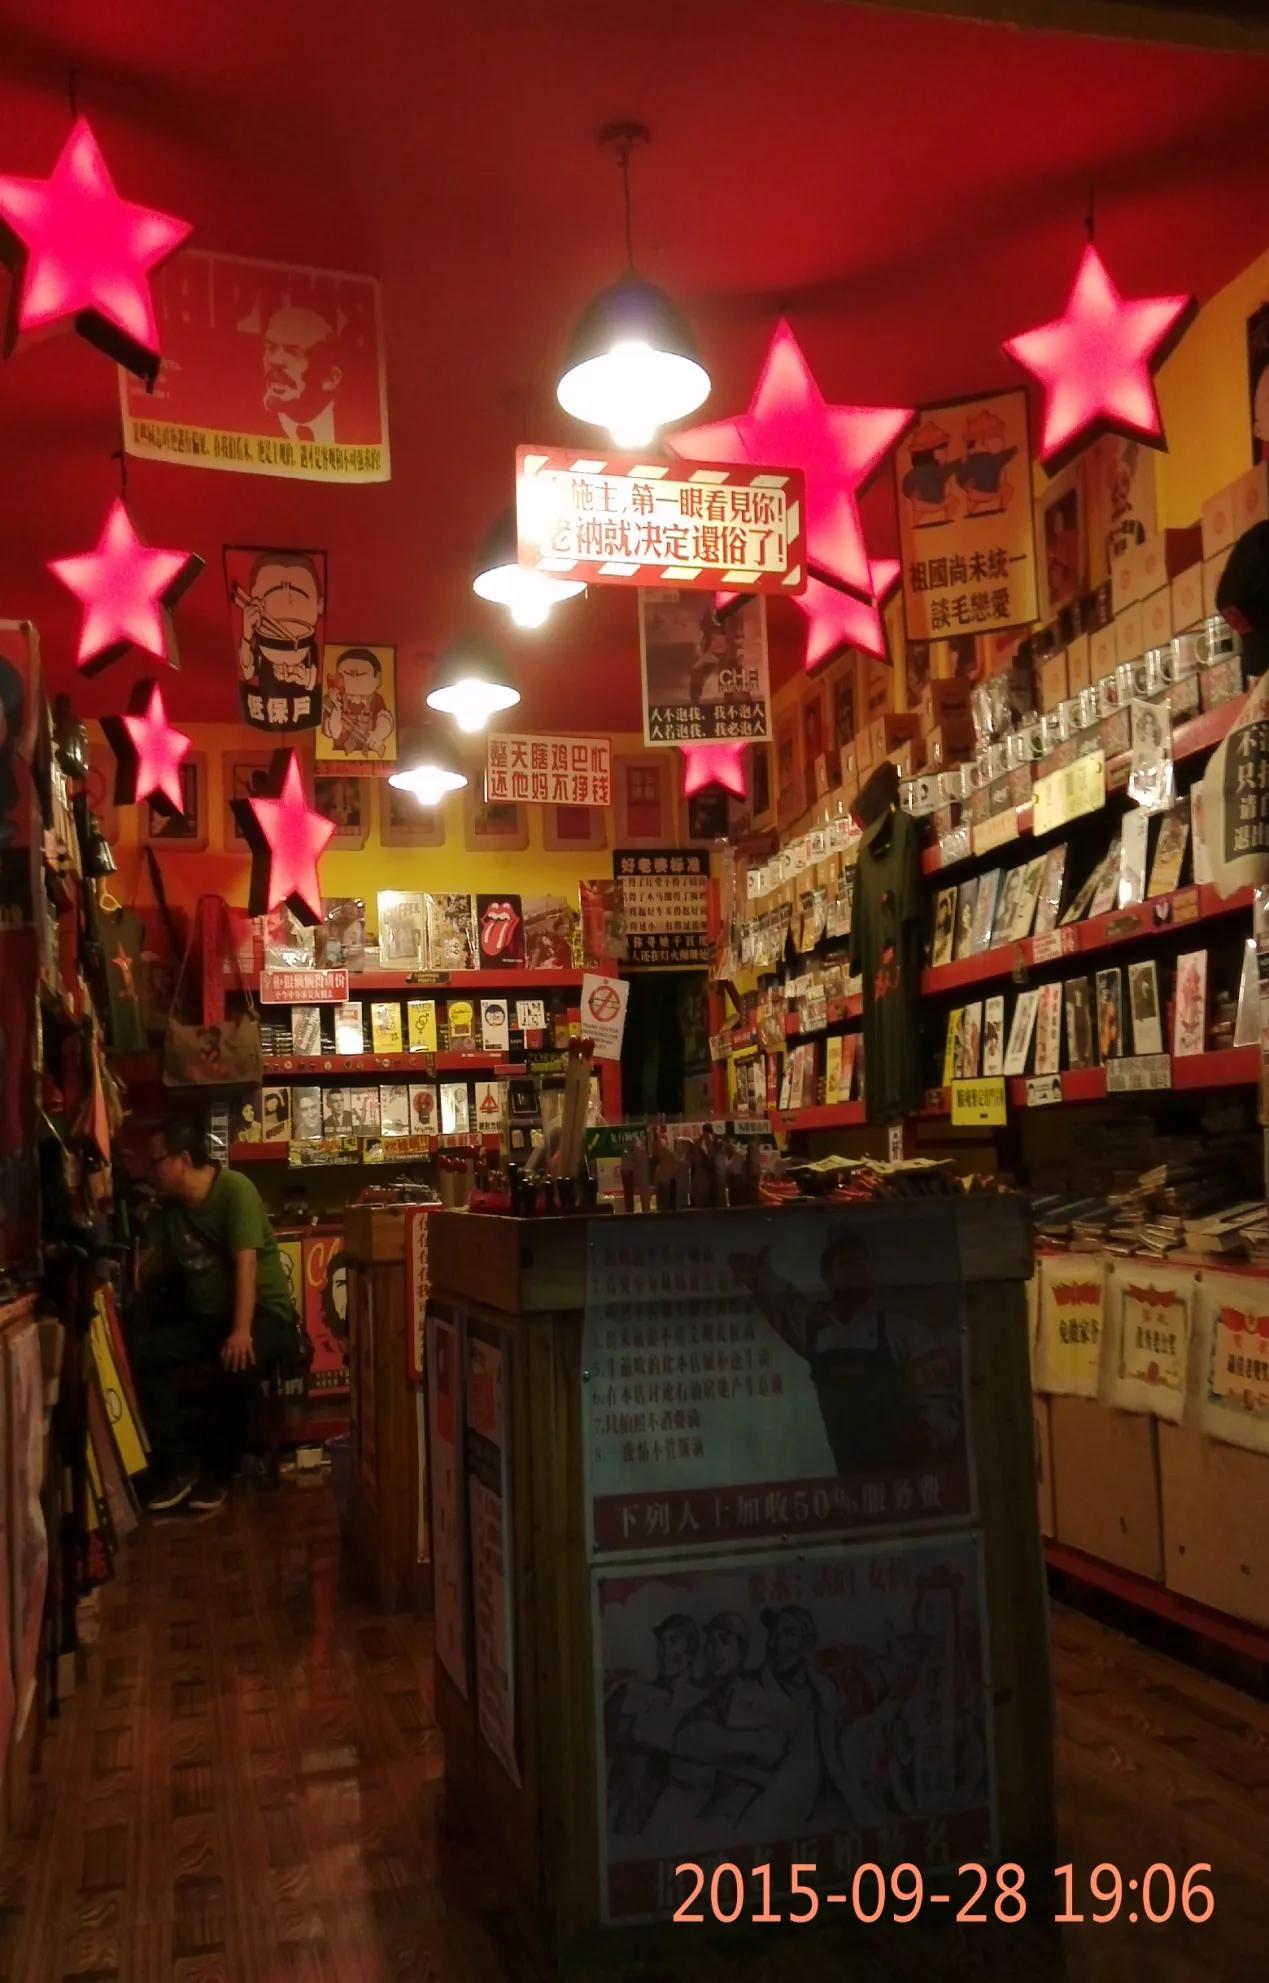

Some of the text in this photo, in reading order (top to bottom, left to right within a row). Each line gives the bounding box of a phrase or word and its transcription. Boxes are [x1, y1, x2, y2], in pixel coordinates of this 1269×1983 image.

[909, 548, 1027, 592] 祖國尚未統一
[931, 588, 1010, 630] 談毛戀愛
[490, 740, 608, 774] 整天瞎鸡巴忙
[490, 769, 609, 803] 还他妈不挣钱
